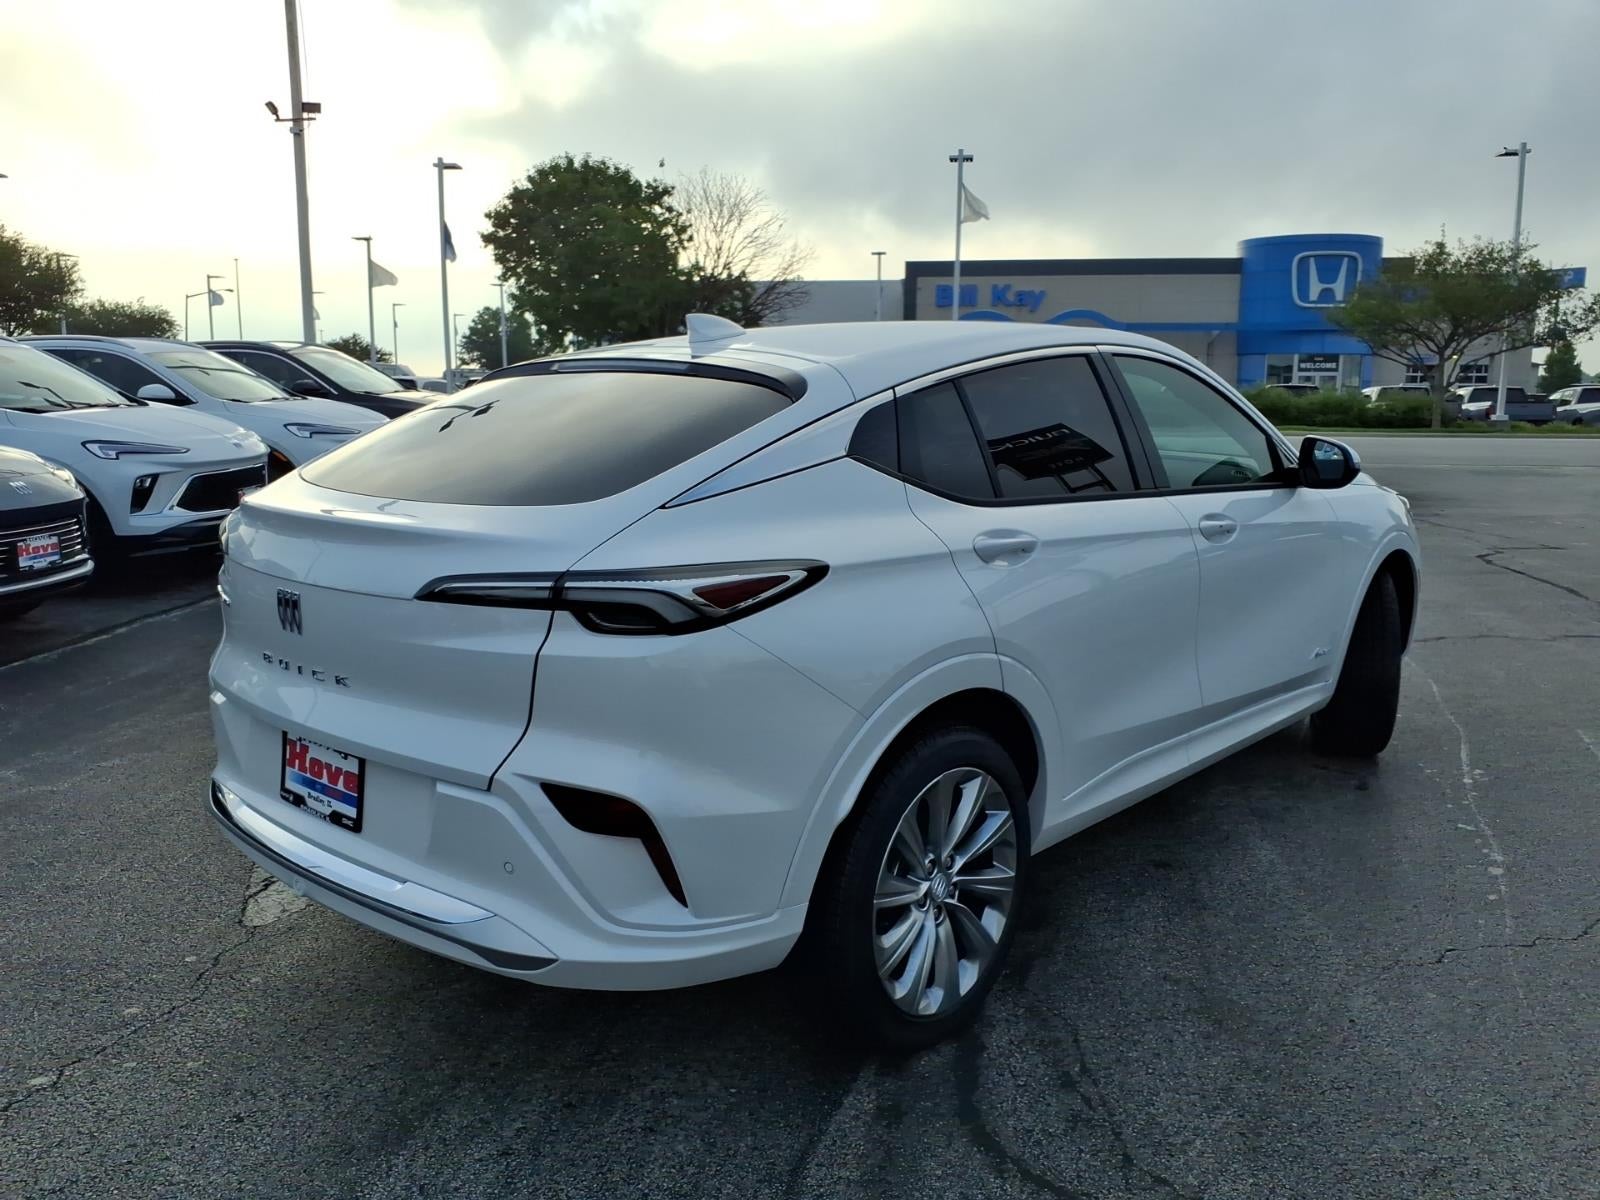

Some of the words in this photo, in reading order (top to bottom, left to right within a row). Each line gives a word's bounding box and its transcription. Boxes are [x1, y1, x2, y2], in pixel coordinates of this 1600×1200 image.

[936, 284, 977, 307] Bll
[991, 284, 1046, 312] Kay
[263, 651, 351, 688] BUICK
